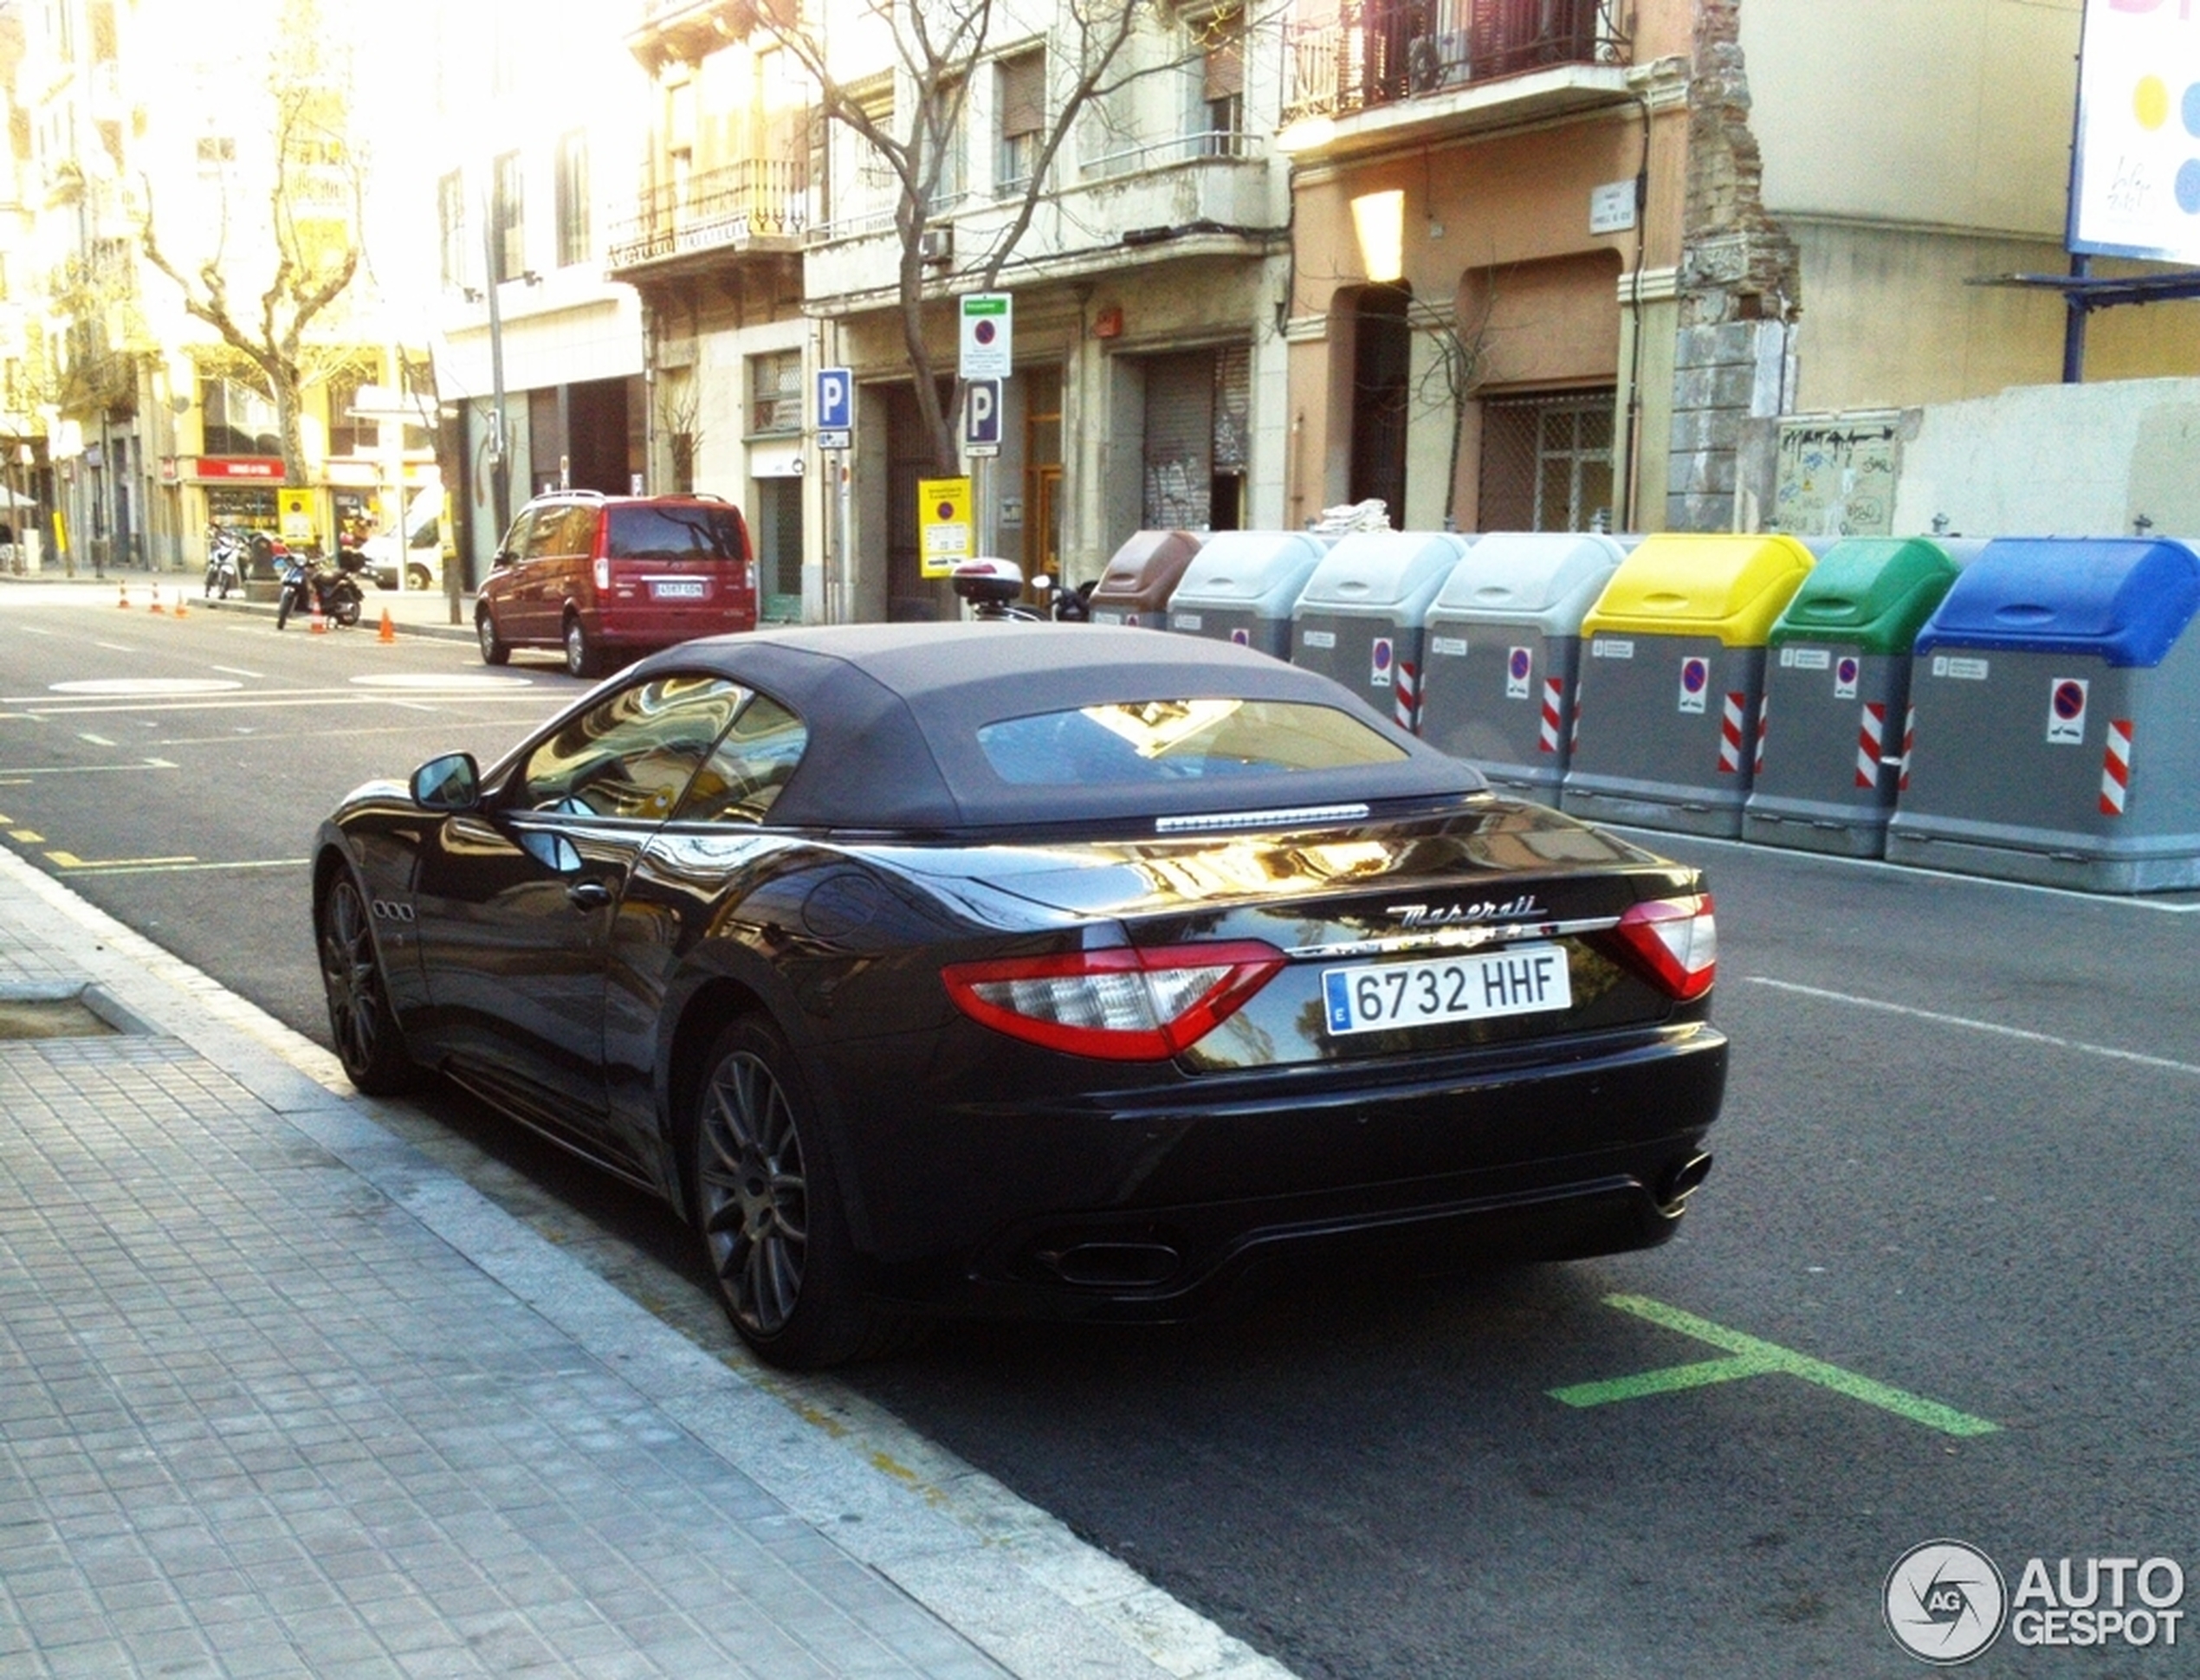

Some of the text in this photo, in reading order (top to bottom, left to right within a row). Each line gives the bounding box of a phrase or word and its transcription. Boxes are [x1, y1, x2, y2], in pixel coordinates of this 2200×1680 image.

[823, 377, 843, 422] P
[971, 387, 993, 437] P
[1386, 895, 1548, 928] Maserati
[1335, 956, 1555, 1022] E 6732 HHF
